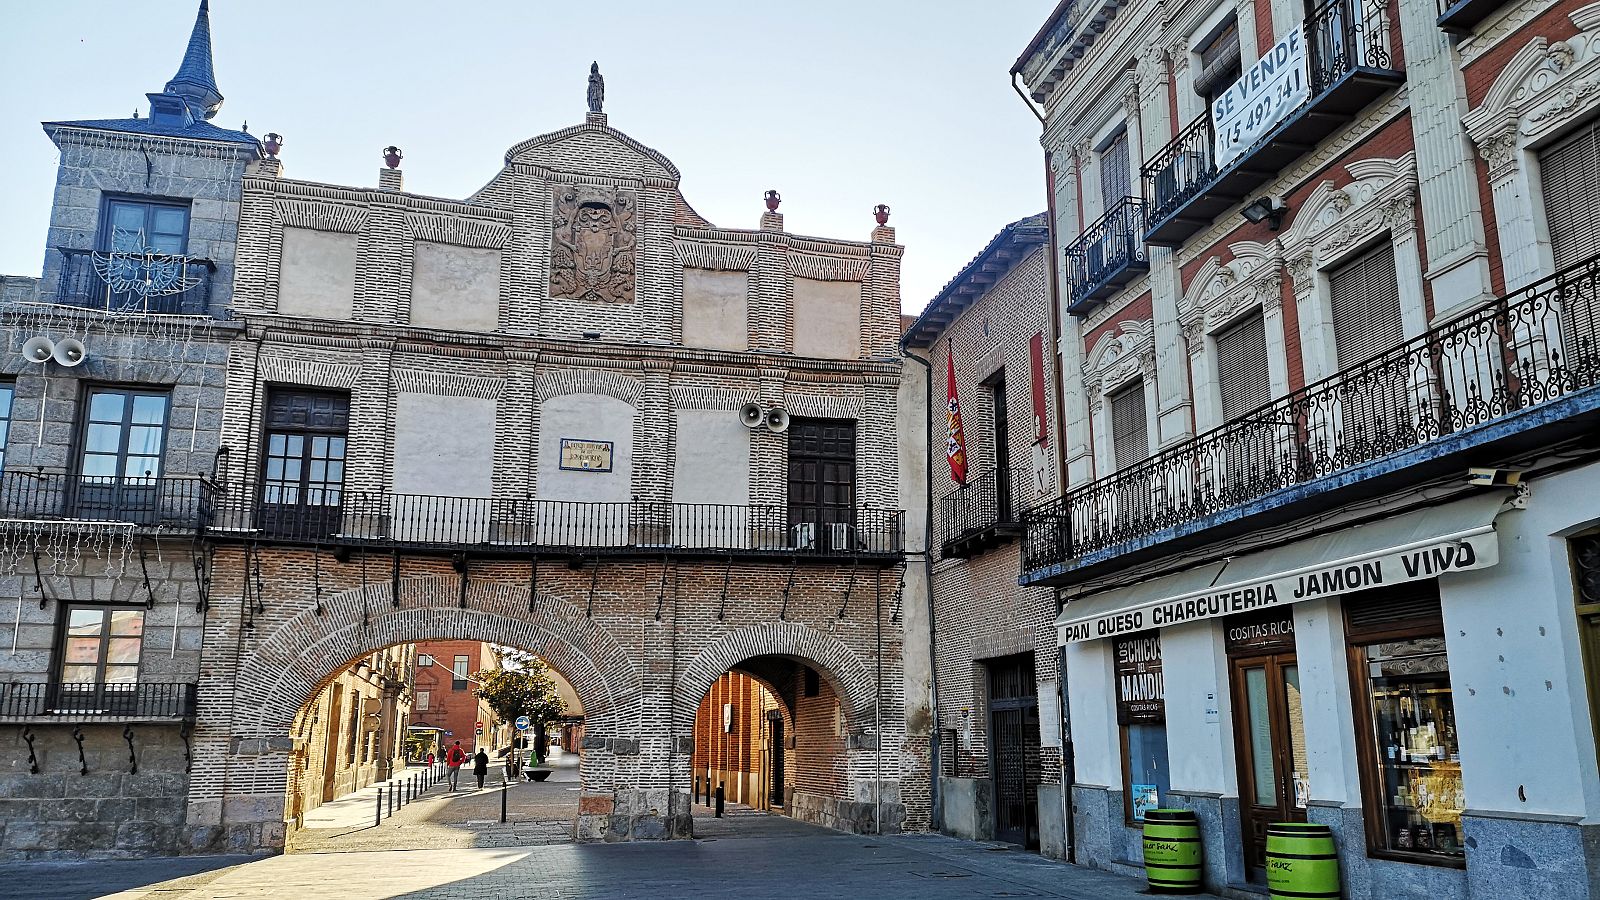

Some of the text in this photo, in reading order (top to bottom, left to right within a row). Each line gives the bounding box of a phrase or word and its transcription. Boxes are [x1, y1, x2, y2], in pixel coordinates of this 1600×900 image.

[1216, 29, 1299, 122] SE VENDE
[1245, 96, 1271, 132] 492
[1275, 68, 1301, 108] 341
[1065, 541, 1477, 643] PAN QUESO CHARCUTERIA JAMON VINO
[1230, 624, 1268, 641] COSITAS
[1118, 641, 1128, 664] LOS
[1127, 637, 1162, 664] CHICOS
[1137, 662, 1146, 673] DEL
[1121, 672, 1164, 702] MANDIL
[1130, 703, 1158, 712] COSITAS RICAS
